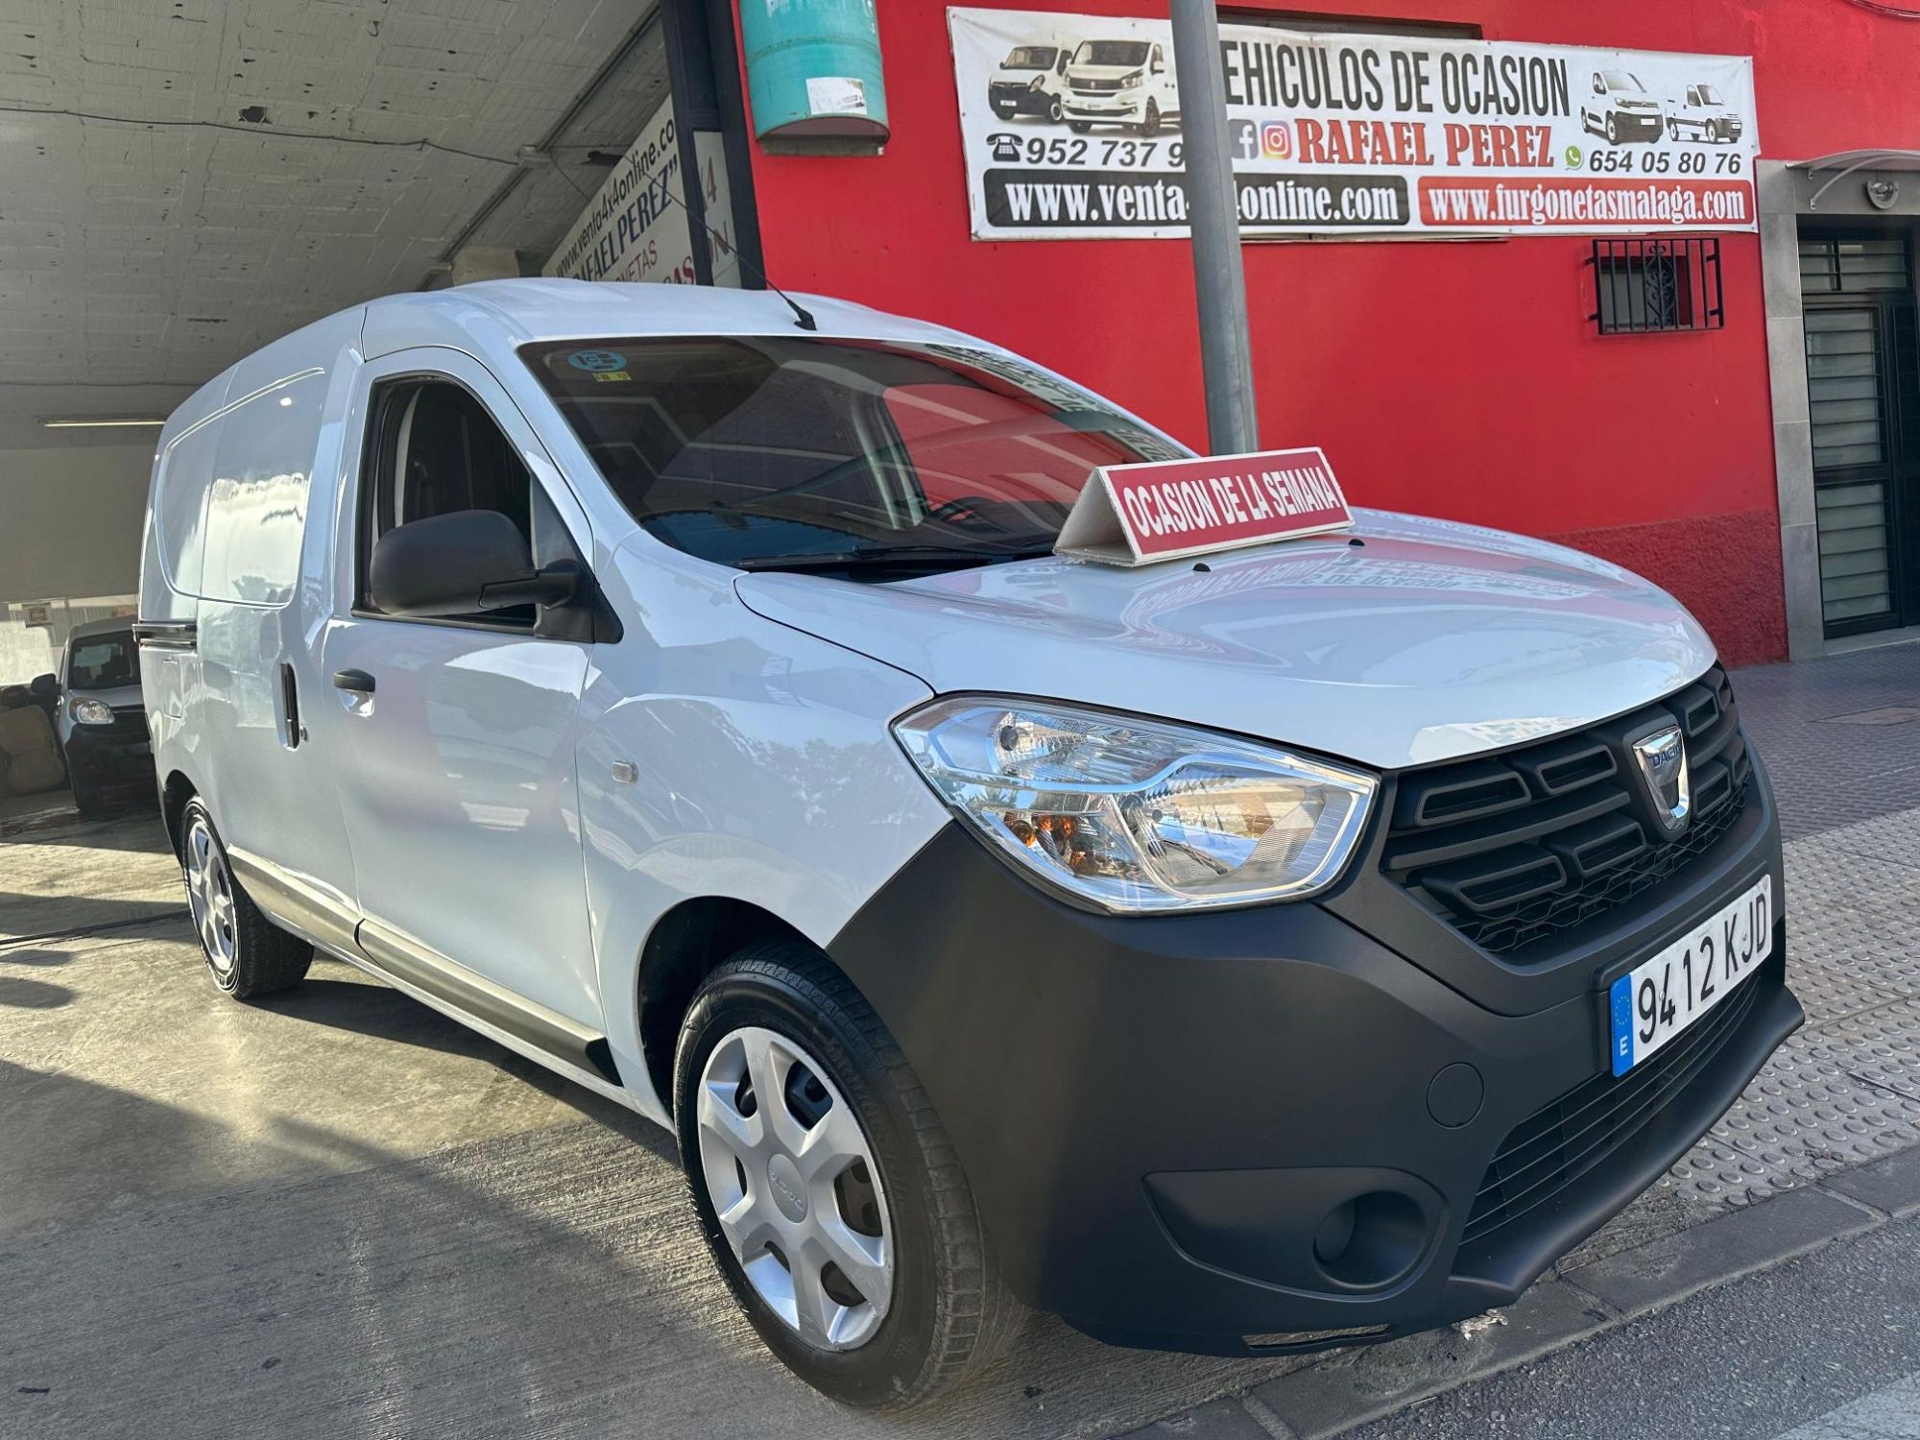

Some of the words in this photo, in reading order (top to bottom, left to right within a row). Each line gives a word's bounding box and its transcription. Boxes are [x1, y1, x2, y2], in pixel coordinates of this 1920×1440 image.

[1219, 40, 1384, 111] EHICULOS
[1391, 50, 1434, 114] DE
[1441, 51, 1570, 117] OCASION
[1026, 137, 1088, 166] 952
[1100, 139, 1158, 168] 737
[1294, 118, 1435, 166] RAFAEL
[1443, 122, 1555, 168] PEREZ
[1589, 149, 1633, 174] 654
[1641, 151, 1670, 174] 05
[1678, 151, 1706, 174] 80
[1715, 152, 1741, 175] 76
[556, 118, 675, 278] www.venta4x4online.co
[1004, 178, 1399, 222] www.ventaonline.com
[1428, 182, 1746, 224] www.furgonetasmalaga.com
[1123, 479, 1222, 537] OCASION
[1209, 475, 1249, 525] DE
[1239, 473, 1275, 520] LA
[1262, 466, 1342, 517] SEMANA
[1638, 935, 1715, 1044] 9412
[1724, 892, 1768, 981] KJD
[1619, 1035, 1629, 1056] E
